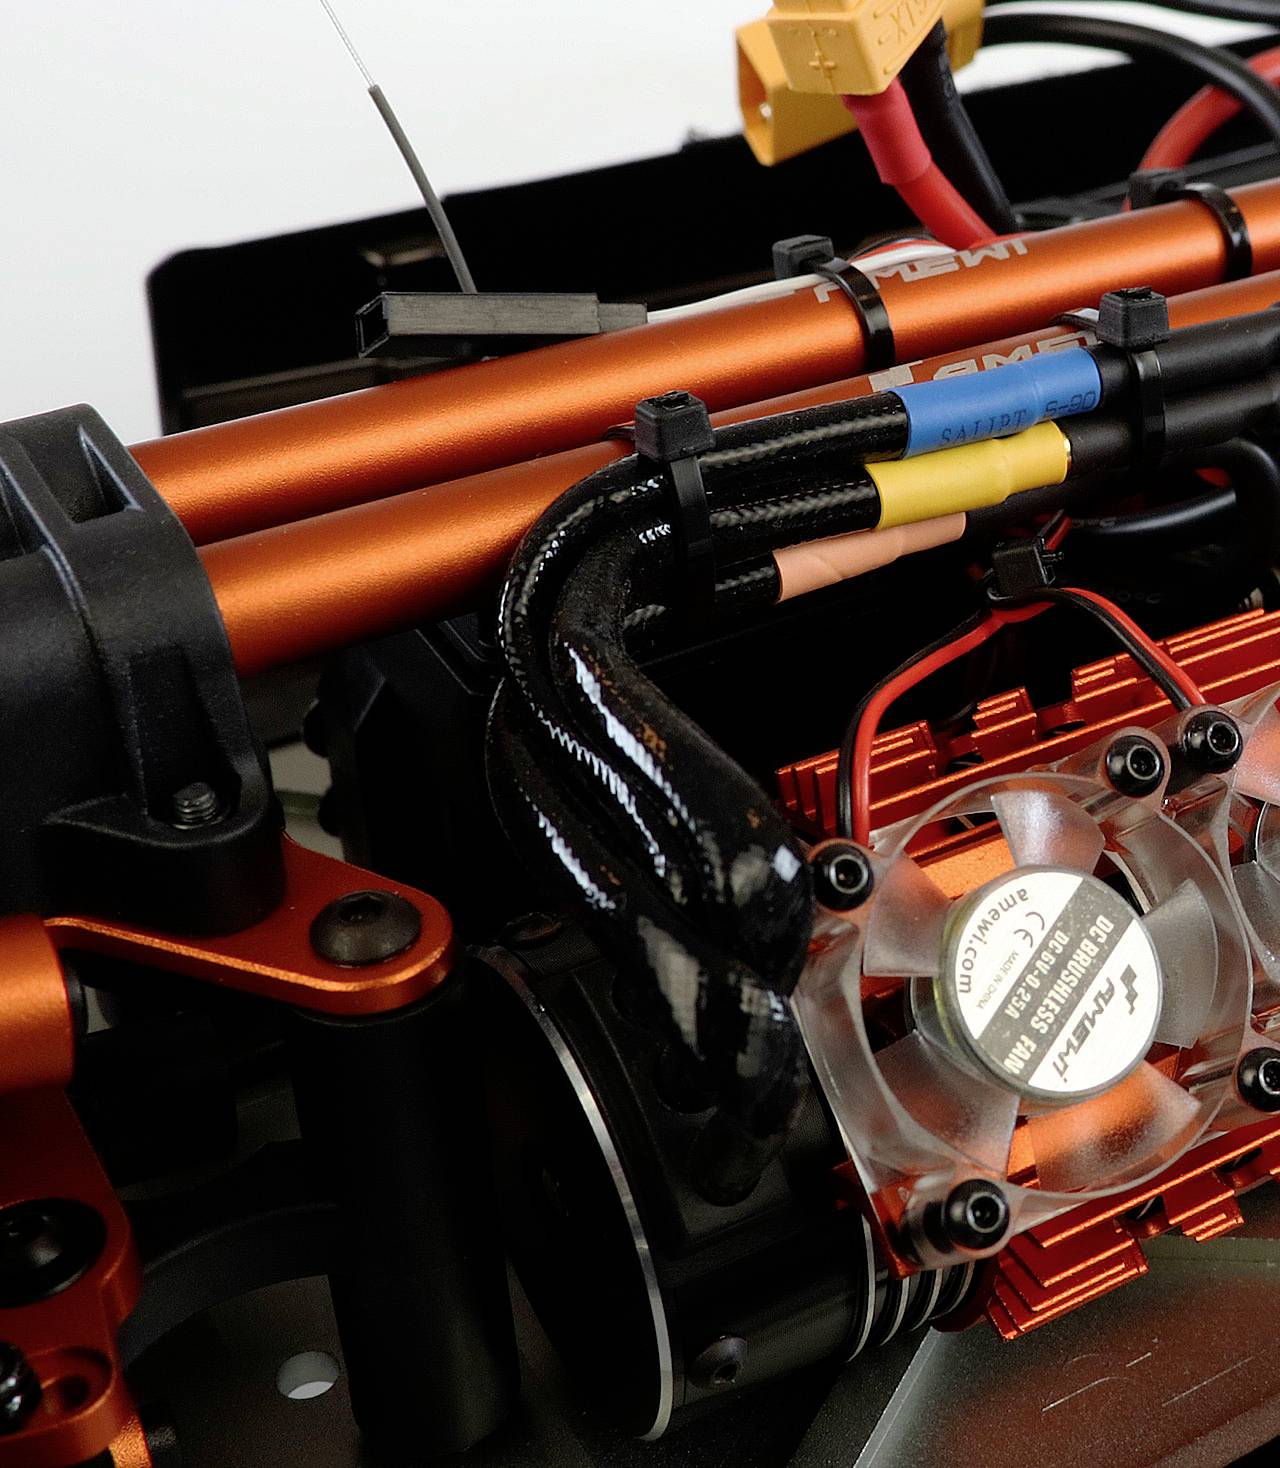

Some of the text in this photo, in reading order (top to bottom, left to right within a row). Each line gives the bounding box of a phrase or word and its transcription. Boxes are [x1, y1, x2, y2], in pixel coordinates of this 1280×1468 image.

[959, 888, 1029, 993] amewi.com
[1003, 915, 1115, 1074] DC BRUSHLESS FAN
